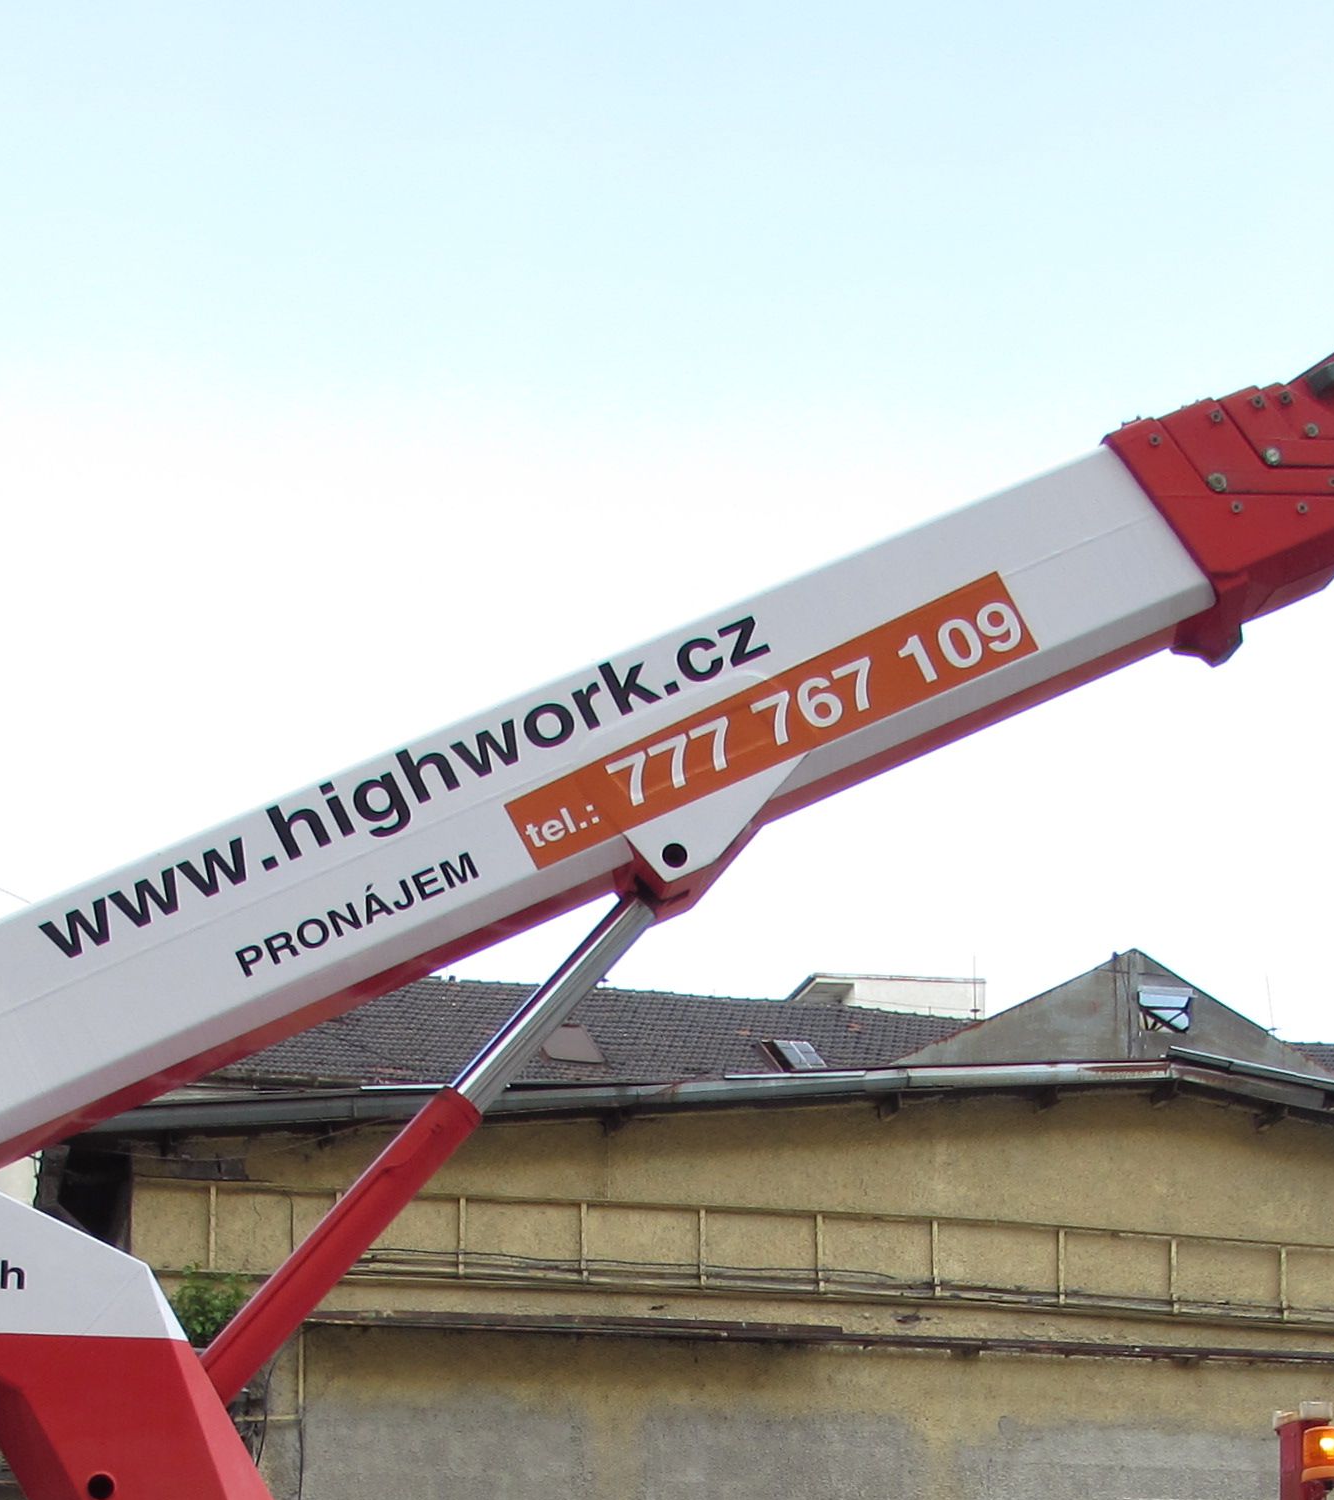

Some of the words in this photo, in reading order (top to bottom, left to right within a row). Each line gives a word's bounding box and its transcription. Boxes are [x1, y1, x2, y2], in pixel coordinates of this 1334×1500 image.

[39, 614, 771, 960] www.highwork.cz
[524, 800, 602, 850] tel.:
[605, 716, 732, 809] 777
[750, 657, 873, 751] 767
[897, 597, 1023, 686] 109
[235, 850, 480, 978] PRONÁJEM
